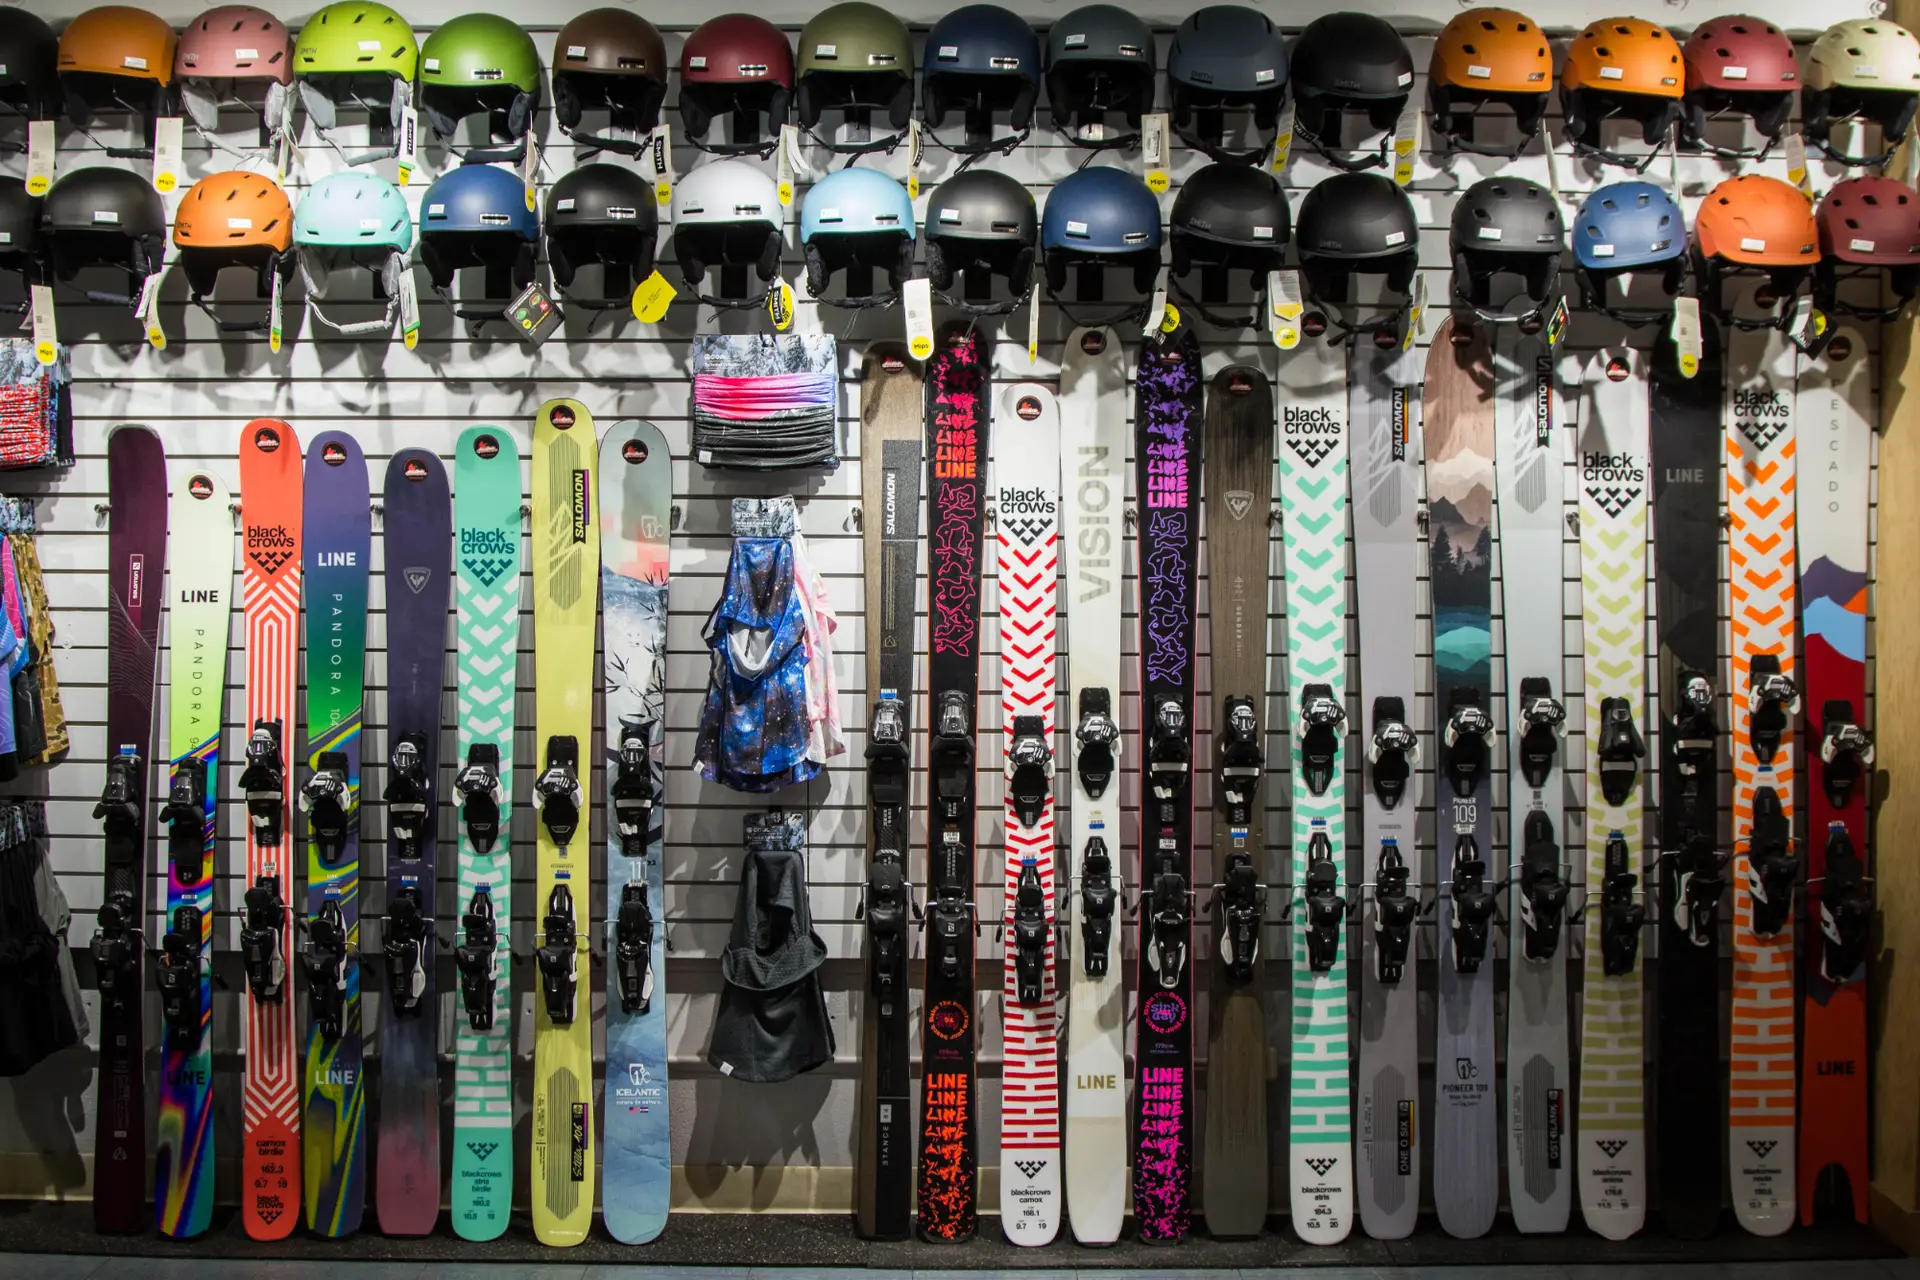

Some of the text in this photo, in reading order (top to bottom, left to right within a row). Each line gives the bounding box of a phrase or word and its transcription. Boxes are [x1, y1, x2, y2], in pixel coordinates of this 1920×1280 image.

[655, 140, 664, 169] SMITH
[772, 290, 780, 320] SMITH
[1734, 389, 1780, 405] black
[1284, 407, 1331, 423] black
[1538, 376, 1548, 438] salomon
[1734, 404, 1790, 418] crows
[1284, 421, 1341, 435] crows
[1395, 389, 1404, 456] SALOMON
[1828, 378, 1840, 513] PESCADO
[935, 446, 977, 462] LINE
[1583, 451, 1633, 469] black
[935, 462, 977, 479] LINE
[1583, 467, 1644, 483] crows
[1666, 468, 1704, 483] LINE
[1147, 475, 1189, 492] LINE
[1000, 487, 1046, 502] black
[1147, 491, 1188, 508] LINE
[574, 472, 584, 539] SALOMON
[886, 473, 895, 535] SALOMON
[1000, 500, 1056, 514] crows
[247, 525, 287, 539] black
[1078, 446, 1111, 604] VISION
[247, 536, 295, 548] crows
[461, 528, 506, 543] black
[461, 541, 515, 555] crows
[318, 552, 357, 567] LINE
[181, 590, 219, 604] LINE
[1235, 606, 1243, 639] SENDER
[330, 593, 343, 696] PANDORA
[190, 628, 205, 727] PANDORA
[1453, 804, 1477, 823] 109
[1152, 1012, 1177, 1024] day
[1143, 1067, 1184, 1084] LINE
[1817, 1060, 1856, 1076] LINE
[167, 1070, 205, 1086] LINE
[315, 1070, 354, 1085] LINE
[927, 1073, 968, 1089] LINE
[1077, 1075, 1117, 1089] LINE
[616, 1088, 661, 1097] ICELANTIC
[1143, 1084, 1184, 1100] LINE
[1442, 1083, 1474, 1092] PIONEER
[927, 1090, 968, 1106] LINE
[1399, 1120, 1409, 1138] SIX
[1548, 1104, 1559, 1139] BLANK
[258, 1148, 284, 1156] birdie
[572, 1122, 583, 1177] Stella 106
[1399, 1149, 1409, 1172] ONE
[1301, 1186, 1342, 1194] blackcrows
[256, 1195, 280, 1203] black
[256, 1201, 284, 1209] crows
[463, 1212, 495, 1220] 10.5 19
[1306, 1221, 1339, 1229] 10.5 20
